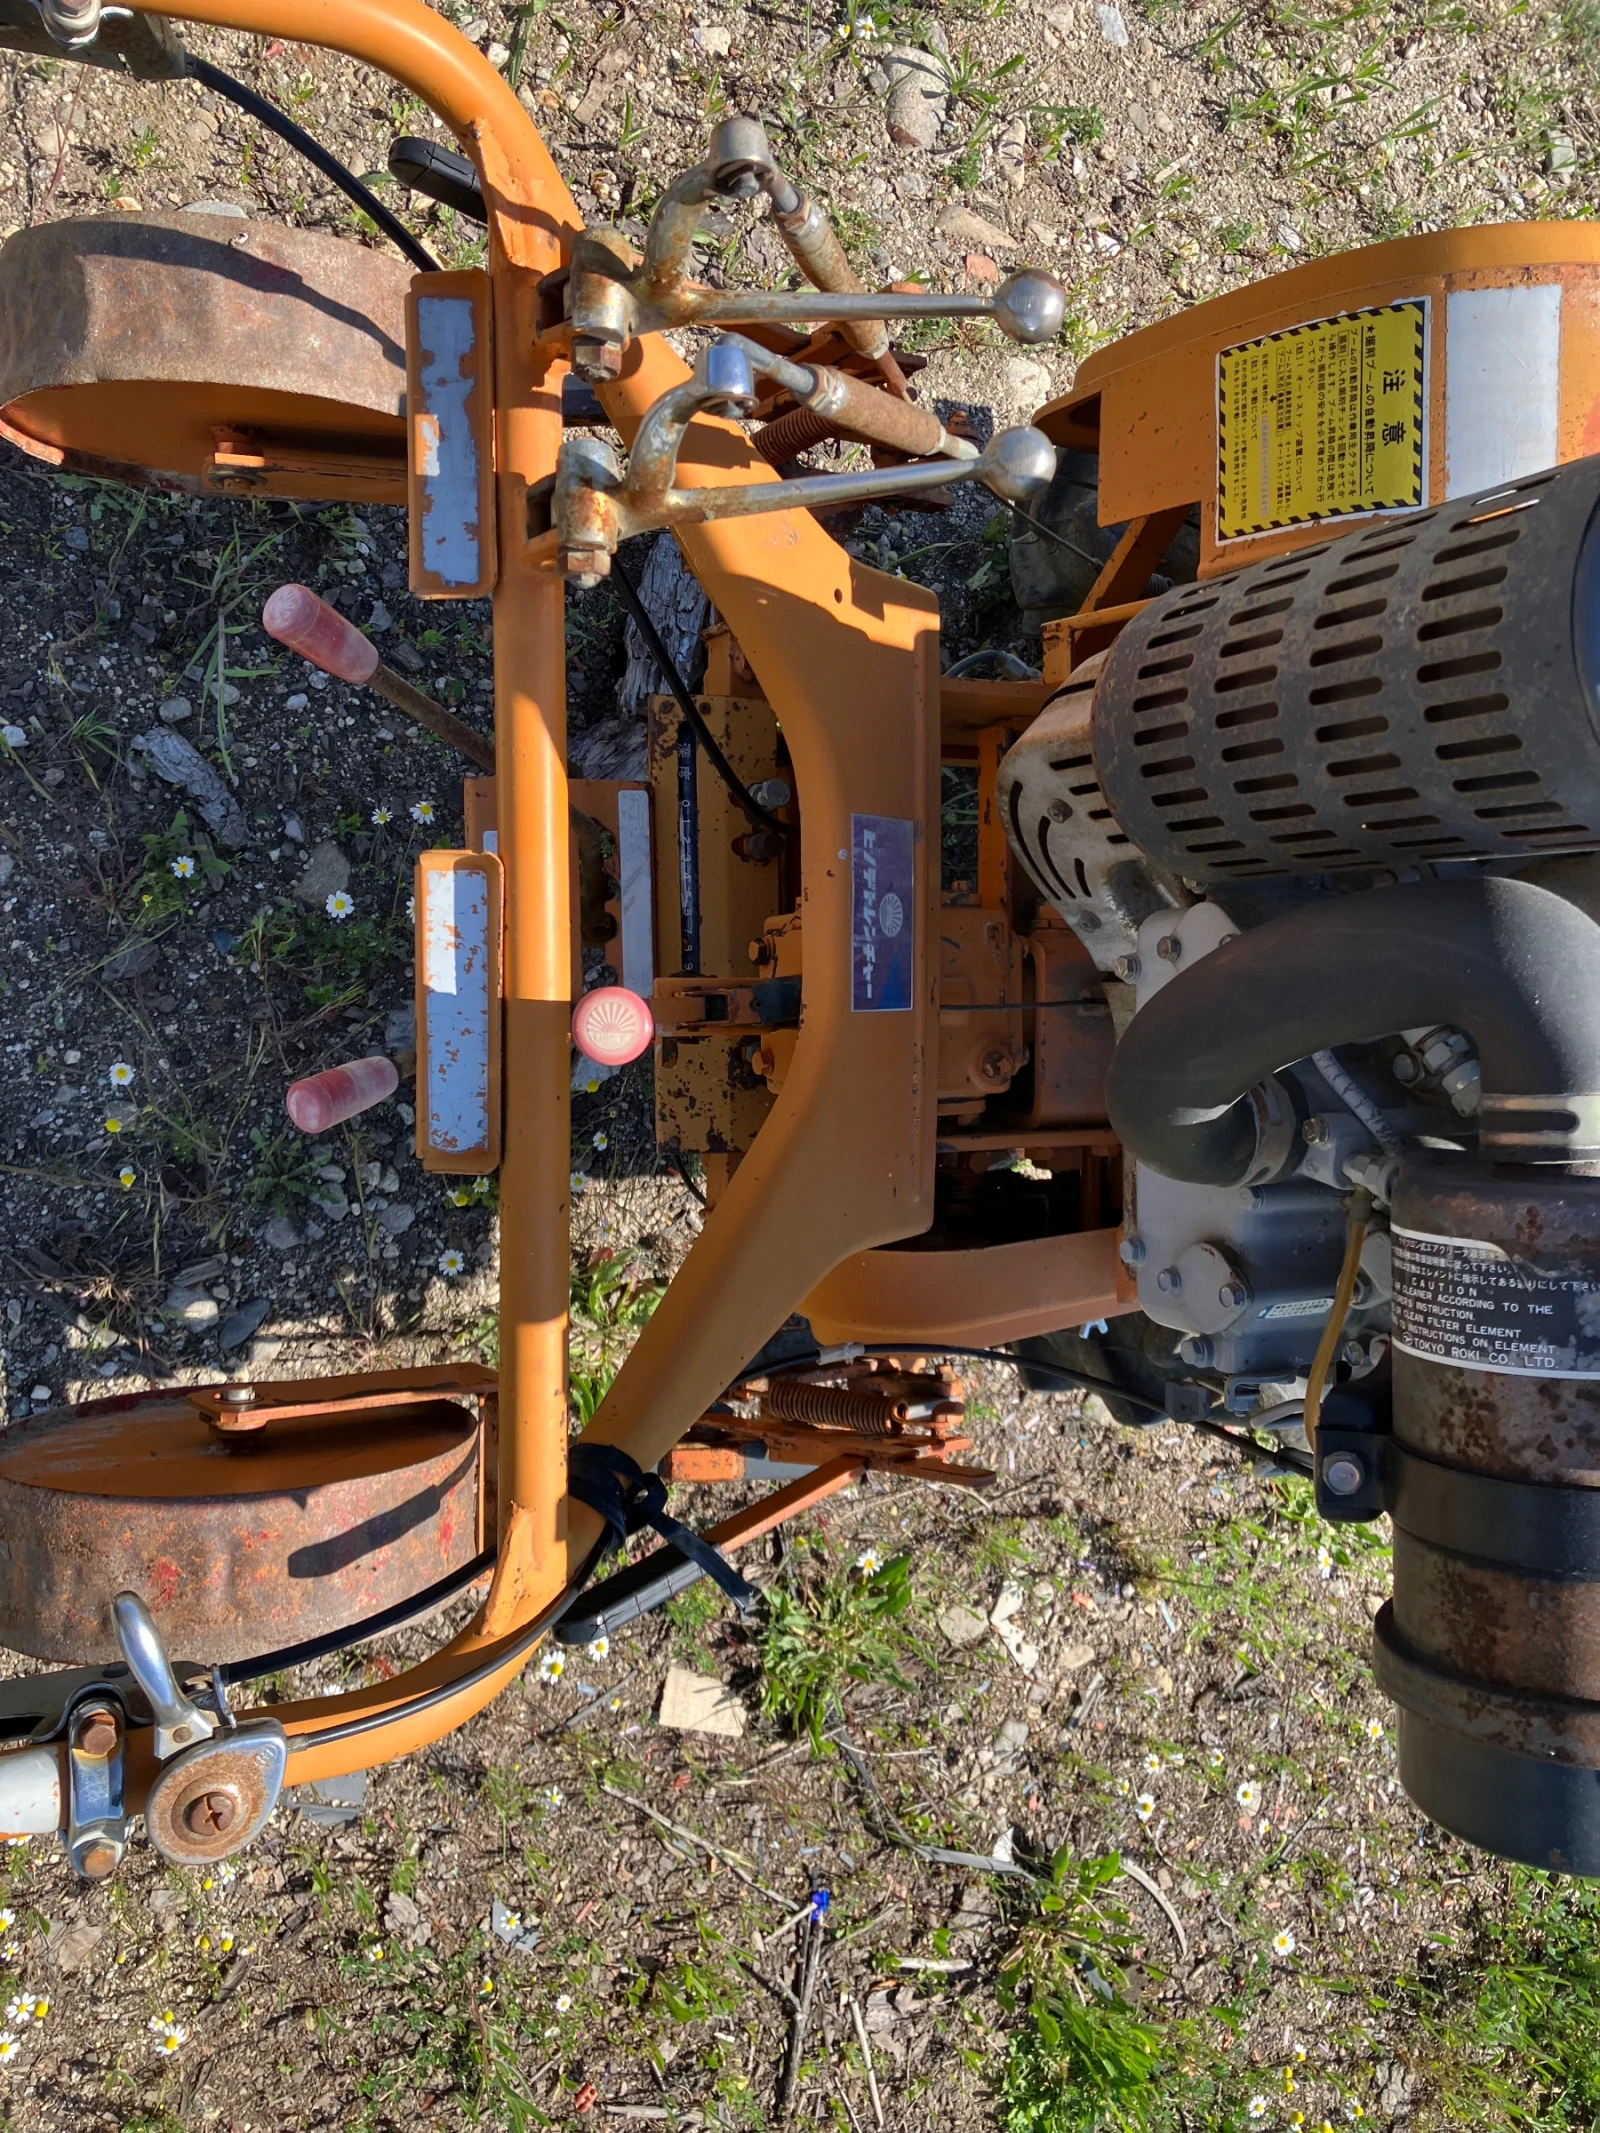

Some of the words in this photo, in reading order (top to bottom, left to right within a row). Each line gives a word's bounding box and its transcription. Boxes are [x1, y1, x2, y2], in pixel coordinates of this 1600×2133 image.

[1308, 339, 1316, 390] って下さい。
[1382, 369, 1407, 446] 注意
[862, 828, 877, 999] ヒノデトレンチャー
[1402, 1285, 1433, 1301] CLEANER
[1437, 1294, 1495, 1310] ACCORDING
[1502, 1302, 1519, 1313] TO
[1527, 1304, 1554, 1315] THE
[1411, 1277, 1478, 1297] CAUTION
[1403, 1308, 1424, 1324] CLEAN
[1427, 1316, 1460, 1331] FILTER
[1465, 1323, 1522, 1339] ELEMENT
[1416, 1300, 1476, 1321] INSTRUCTION.
[1408, 1323, 1466, 1345] INSTRUCTIONS
[1472, 1337, 1488, 1348] ON
[1414, 1337, 1445, 1355] TOKYO
[1451, 1347, 1480, 1361] ROKI
[1525, 1355, 1559, 1369] LTD.
